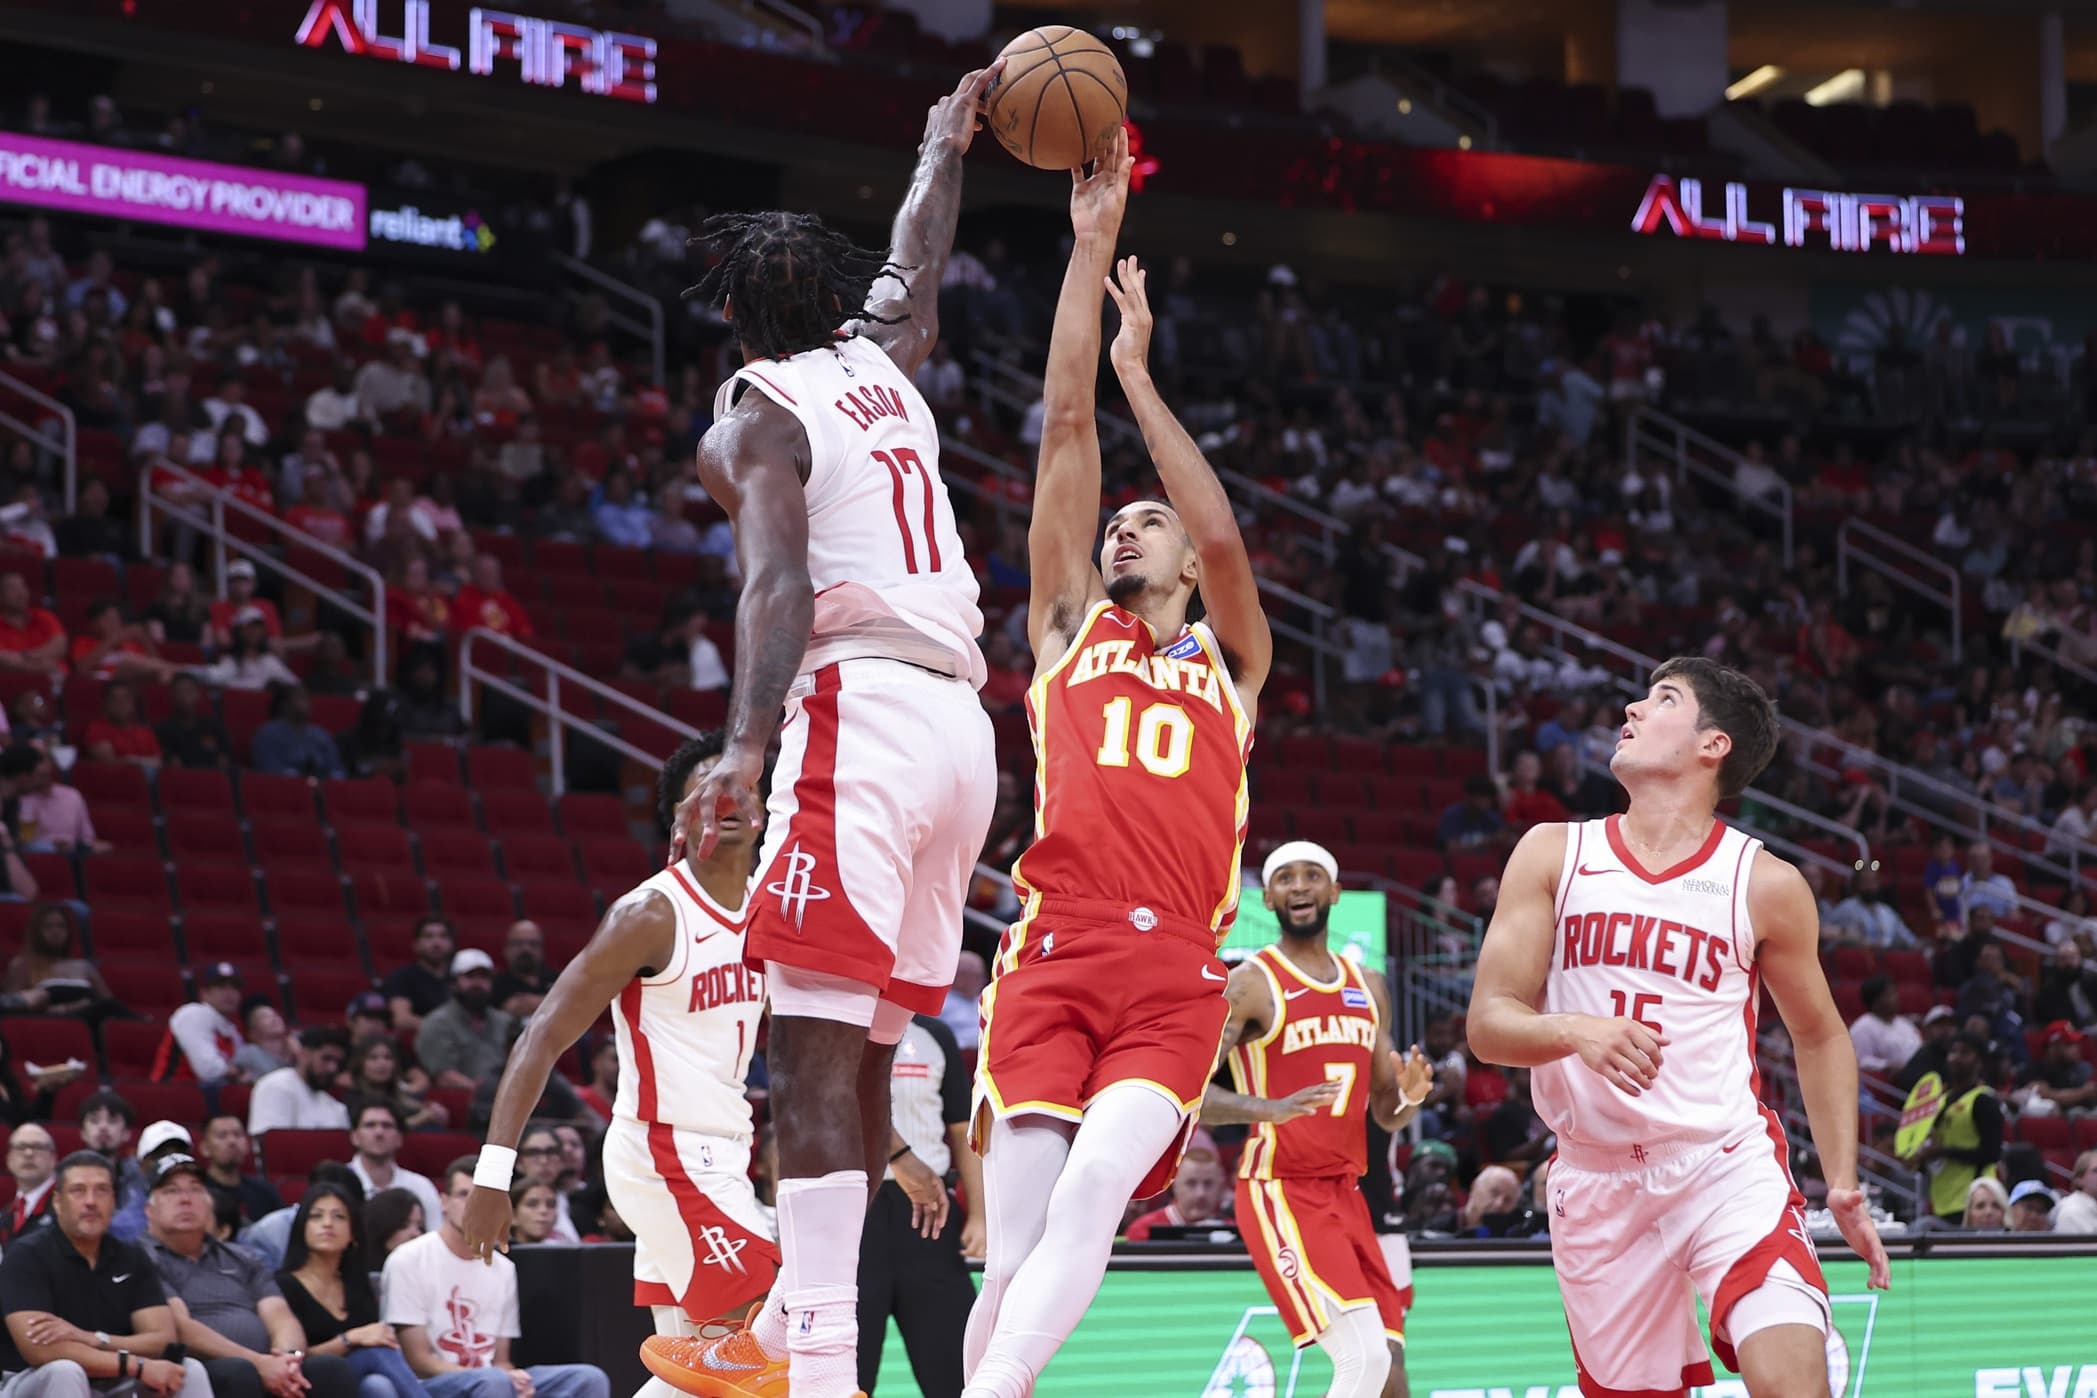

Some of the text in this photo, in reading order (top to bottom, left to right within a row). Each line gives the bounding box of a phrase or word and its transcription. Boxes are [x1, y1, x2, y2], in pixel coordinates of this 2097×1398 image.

[295, 0, 657, 103] ALL FIRE
[91, 162, 211, 215] ENERGY
[211, 179, 355, 233] PROVIDER
[370, 205, 465, 250] reliant
[1631, 173, 1966, 256] ALL FIRE
[835, 384, 910, 432] EASON
[870, 447, 942, 574] 17
[1066, 639, 1223, 716] ATLANTA
[1097, 695, 1195, 778] 10
[1563, 912, 1729, 993] ROCKETS
[734, 1019, 745, 1079] 1
[1324, 1062, 1357, 1117] 7
